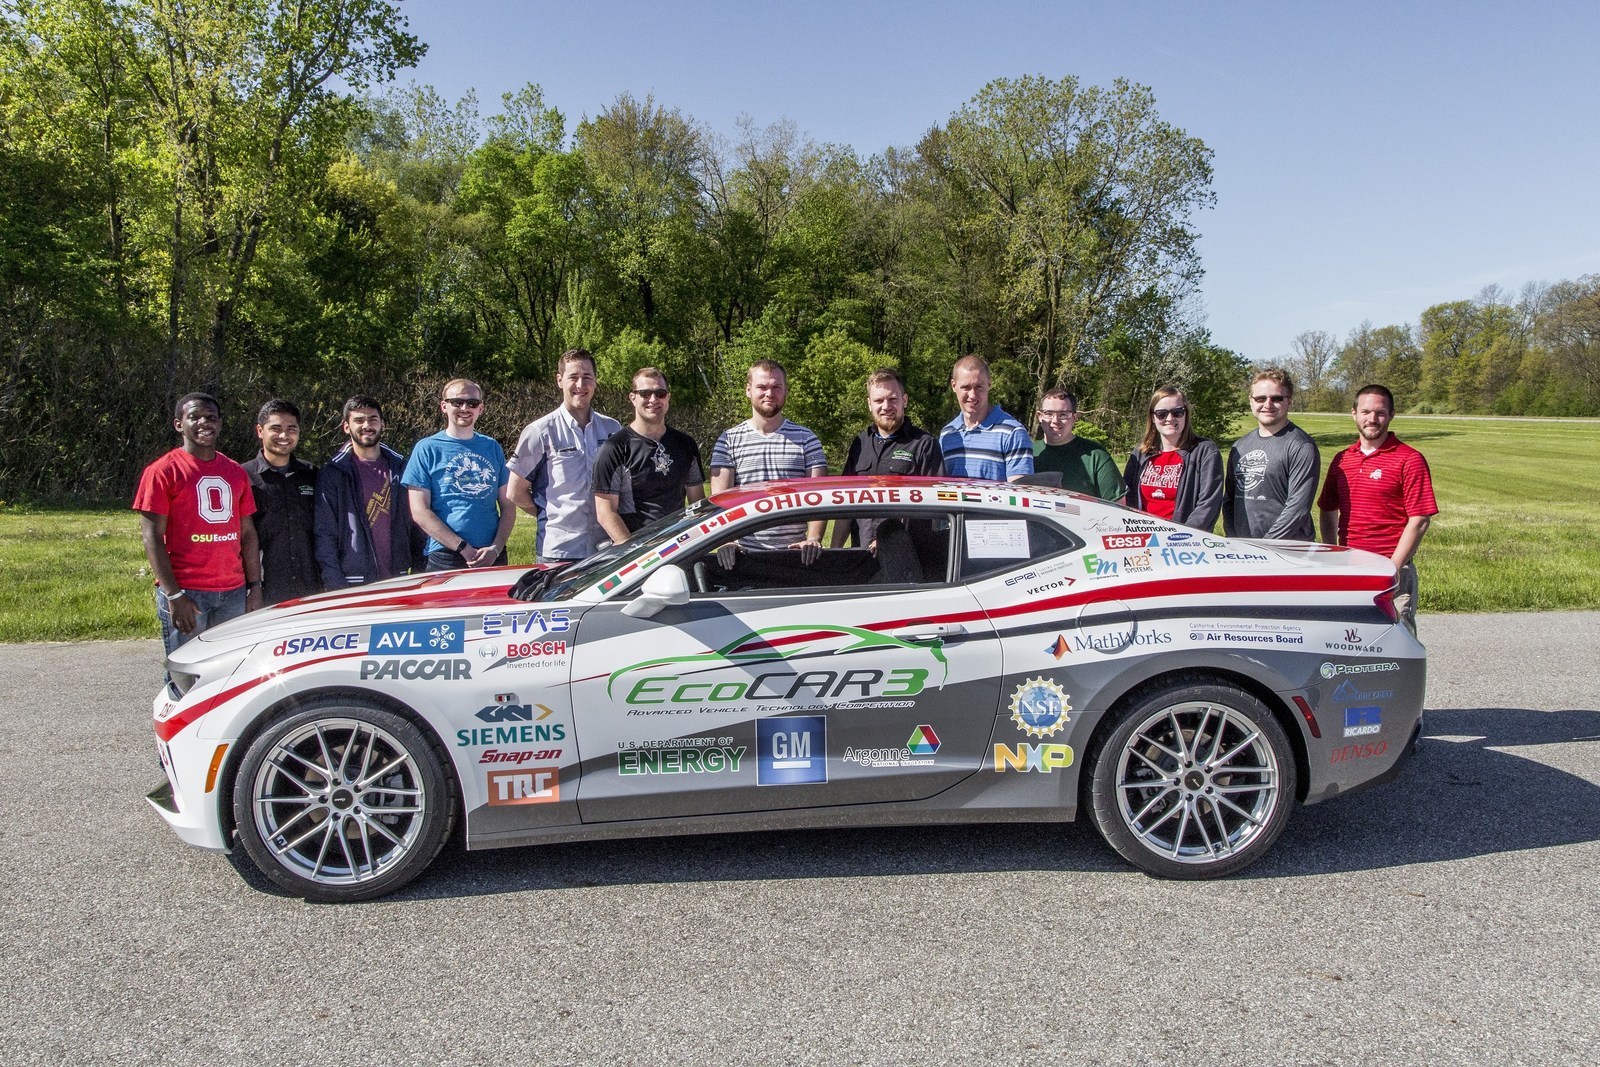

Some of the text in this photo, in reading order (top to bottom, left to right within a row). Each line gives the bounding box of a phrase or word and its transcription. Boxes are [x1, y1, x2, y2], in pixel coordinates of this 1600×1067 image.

[754, 489, 923, 513] OHIO STATE 8
[1125, 525, 1177, 533] Automotive
[1105, 536, 1142, 548] tesa
[1123, 555, 1150, 568] A123
[1161, 548, 1210, 566] flex
[1026, 580, 1064, 595] VECTOR
[483, 609, 570, 635] ETAS
[273, 633, 359, 657] dSPACE
[376, 631, 422, 649] AVL
[1074, 629, 1172, 651] MathWorks
[1206, 633, 1303, 644] Air Resources Board
[506, 641, 566, 658] BOSCH
[1325, 642, 1383, 653] WOODWARD
[360, 659, 472, 681] PACCAR
[507, 660, 540, 669] Invented
[1335, 662, 1400, 675] PROTERRA
[1021, 700, 1060, 716] NSF
[456, 724, 566, 747] SIEMENS
[1345, 725, 1380, 736] RICARDO
[618, 737, 733, 749] U.S. DEPARTMENT OF
[772, 731, 811, 759] GM
[478, 749, 562, 764] Snap-on
[618, 746, 747, 776] ENERGY
[842, 746, 910, 766] Argonne
[994, 743, 1074, 773] NXP
[1330, 740, 1388, 766] DENSO
